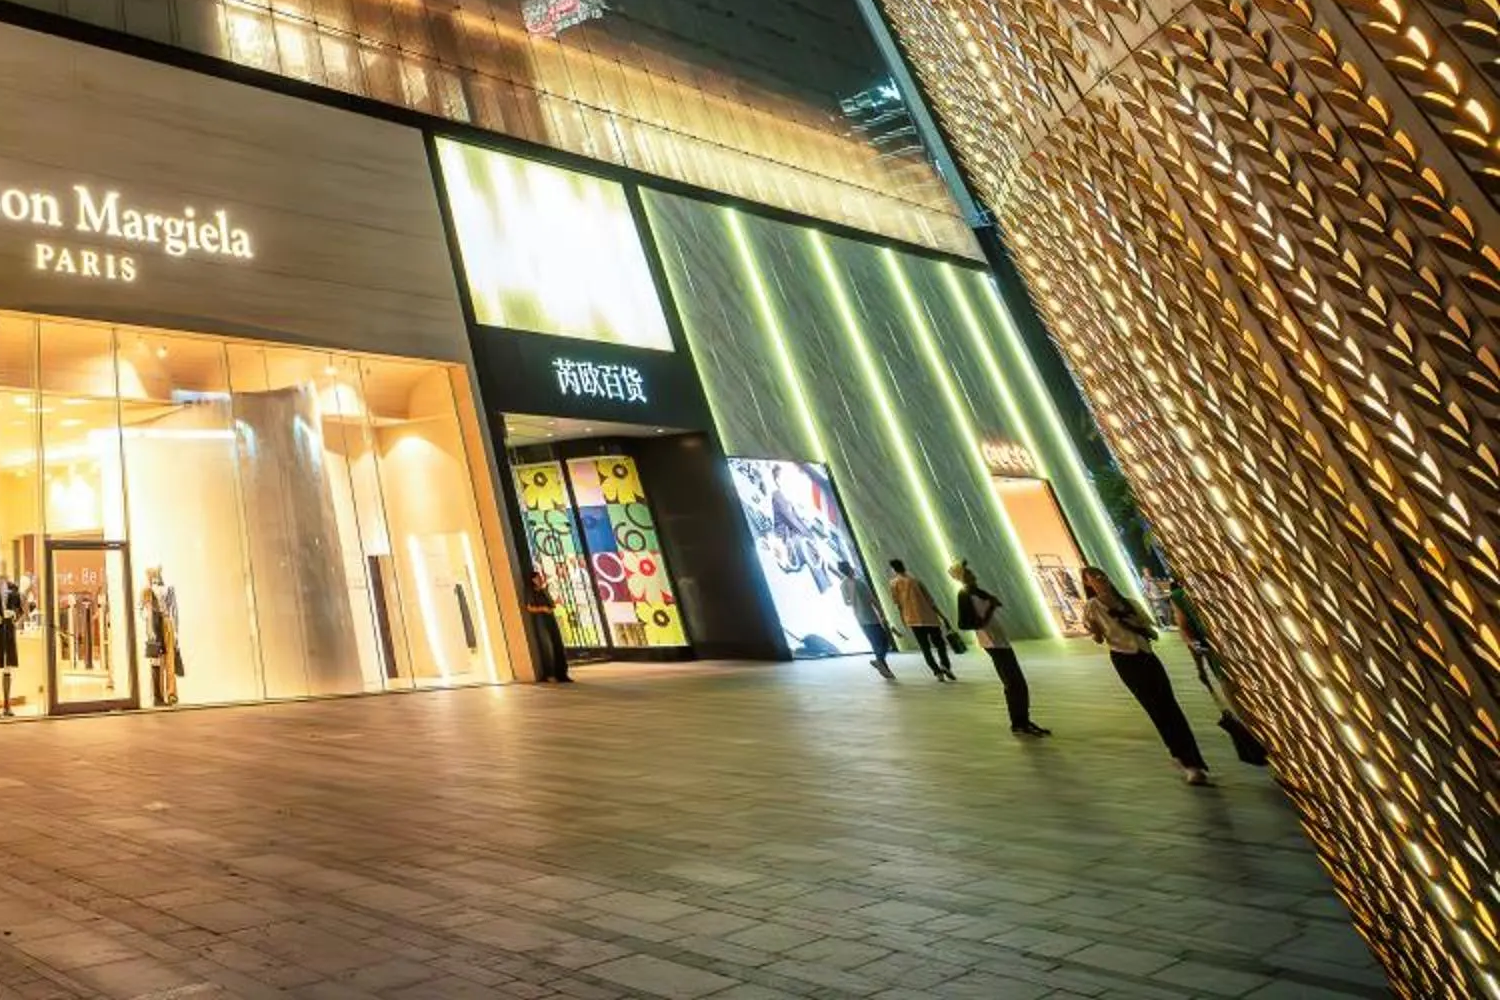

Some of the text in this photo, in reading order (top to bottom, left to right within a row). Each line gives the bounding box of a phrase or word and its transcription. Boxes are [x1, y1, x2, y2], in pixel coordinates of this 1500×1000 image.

[72, 185, 254, 260] Margiela
[34, 243, 137, 283] PARIS
[552, 357, 648, 404] 芮欧百货
